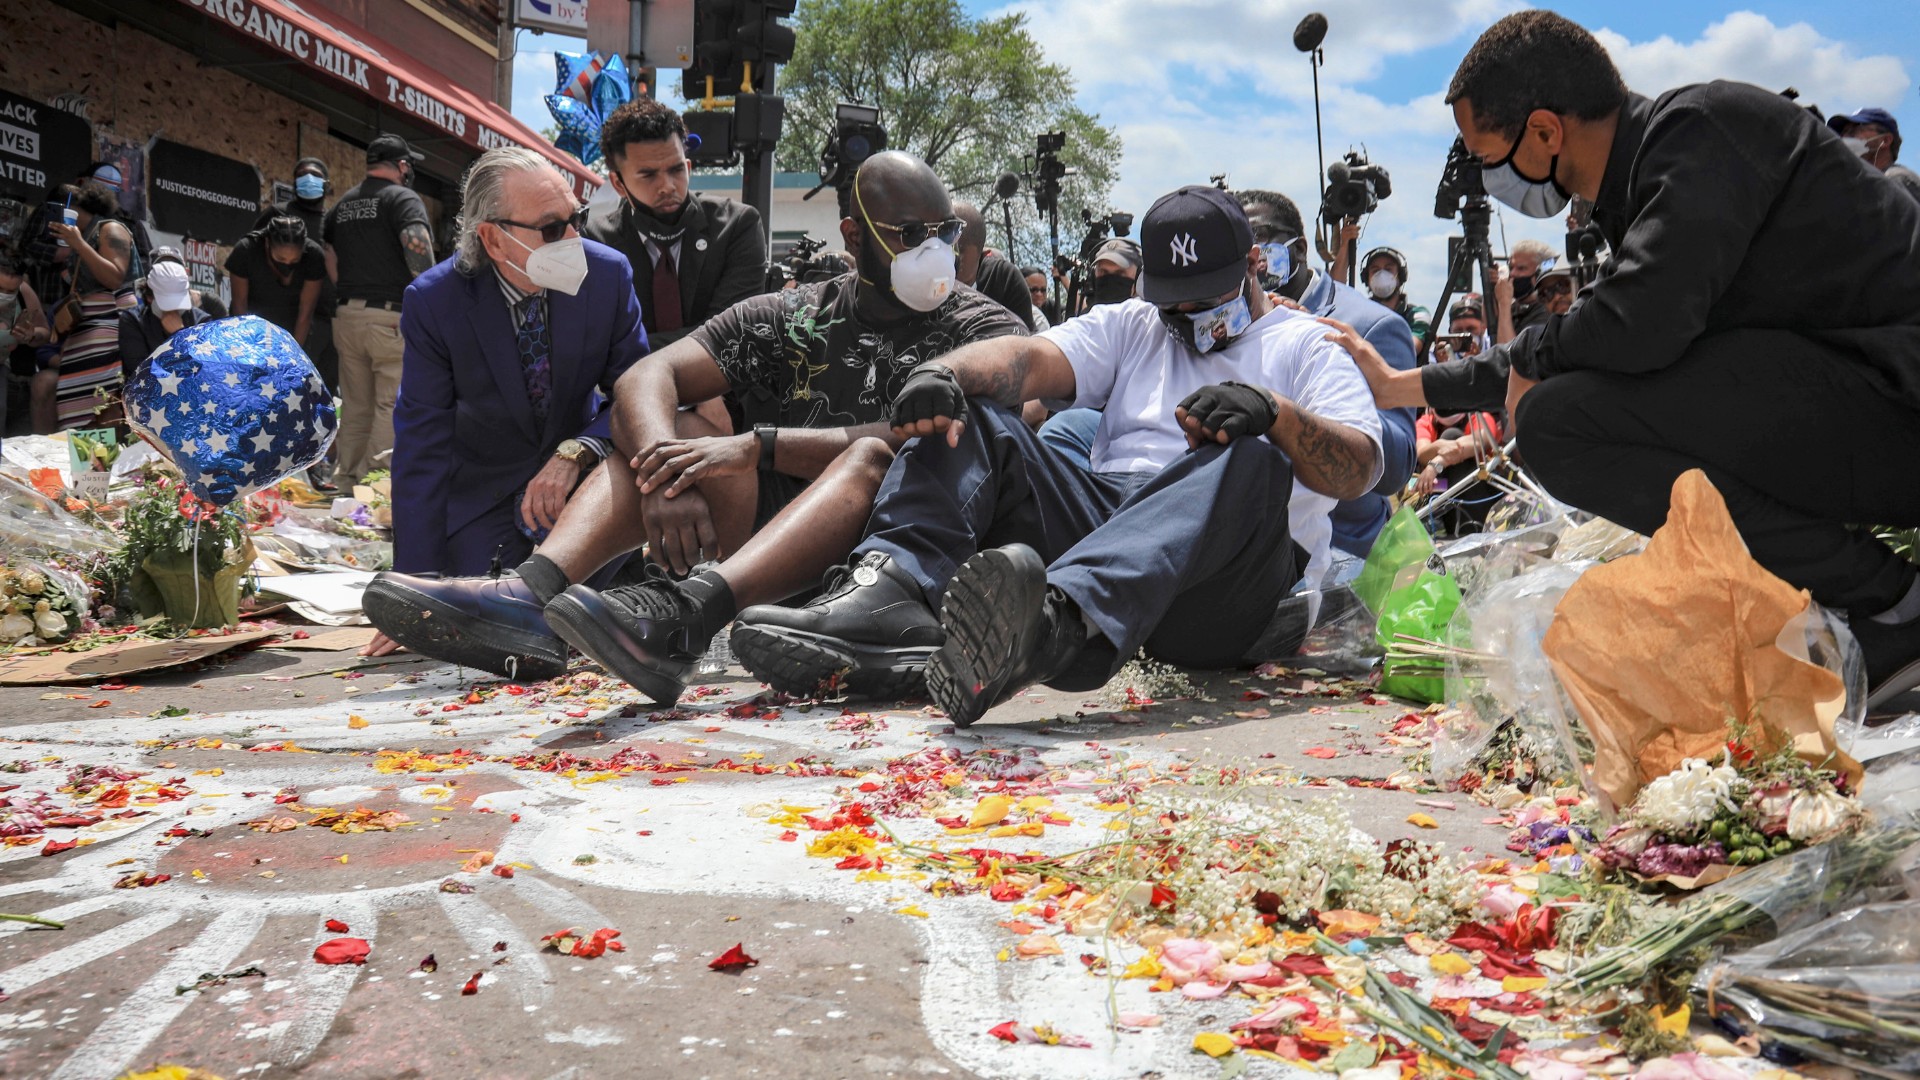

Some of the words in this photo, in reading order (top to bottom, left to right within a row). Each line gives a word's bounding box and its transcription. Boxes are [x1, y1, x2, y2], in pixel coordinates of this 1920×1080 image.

[558, 3, 576, 23] by
[190, 0, 309, 59] RGANIC
[314, 39, 370, 91] MILK
[386, 75, 466, 137] T-SHIRTS
[0, 129, 34, 154] IVES
[0, 161, 46, 188] ATTER
[156, 178, 257, 212] #JUSTICEFORGEORGFLOYD
[336, 207, 378, 224] SERVICES
[186, 241, 216, 265] BLACK
[1169, 231, 1199, 267] NY
